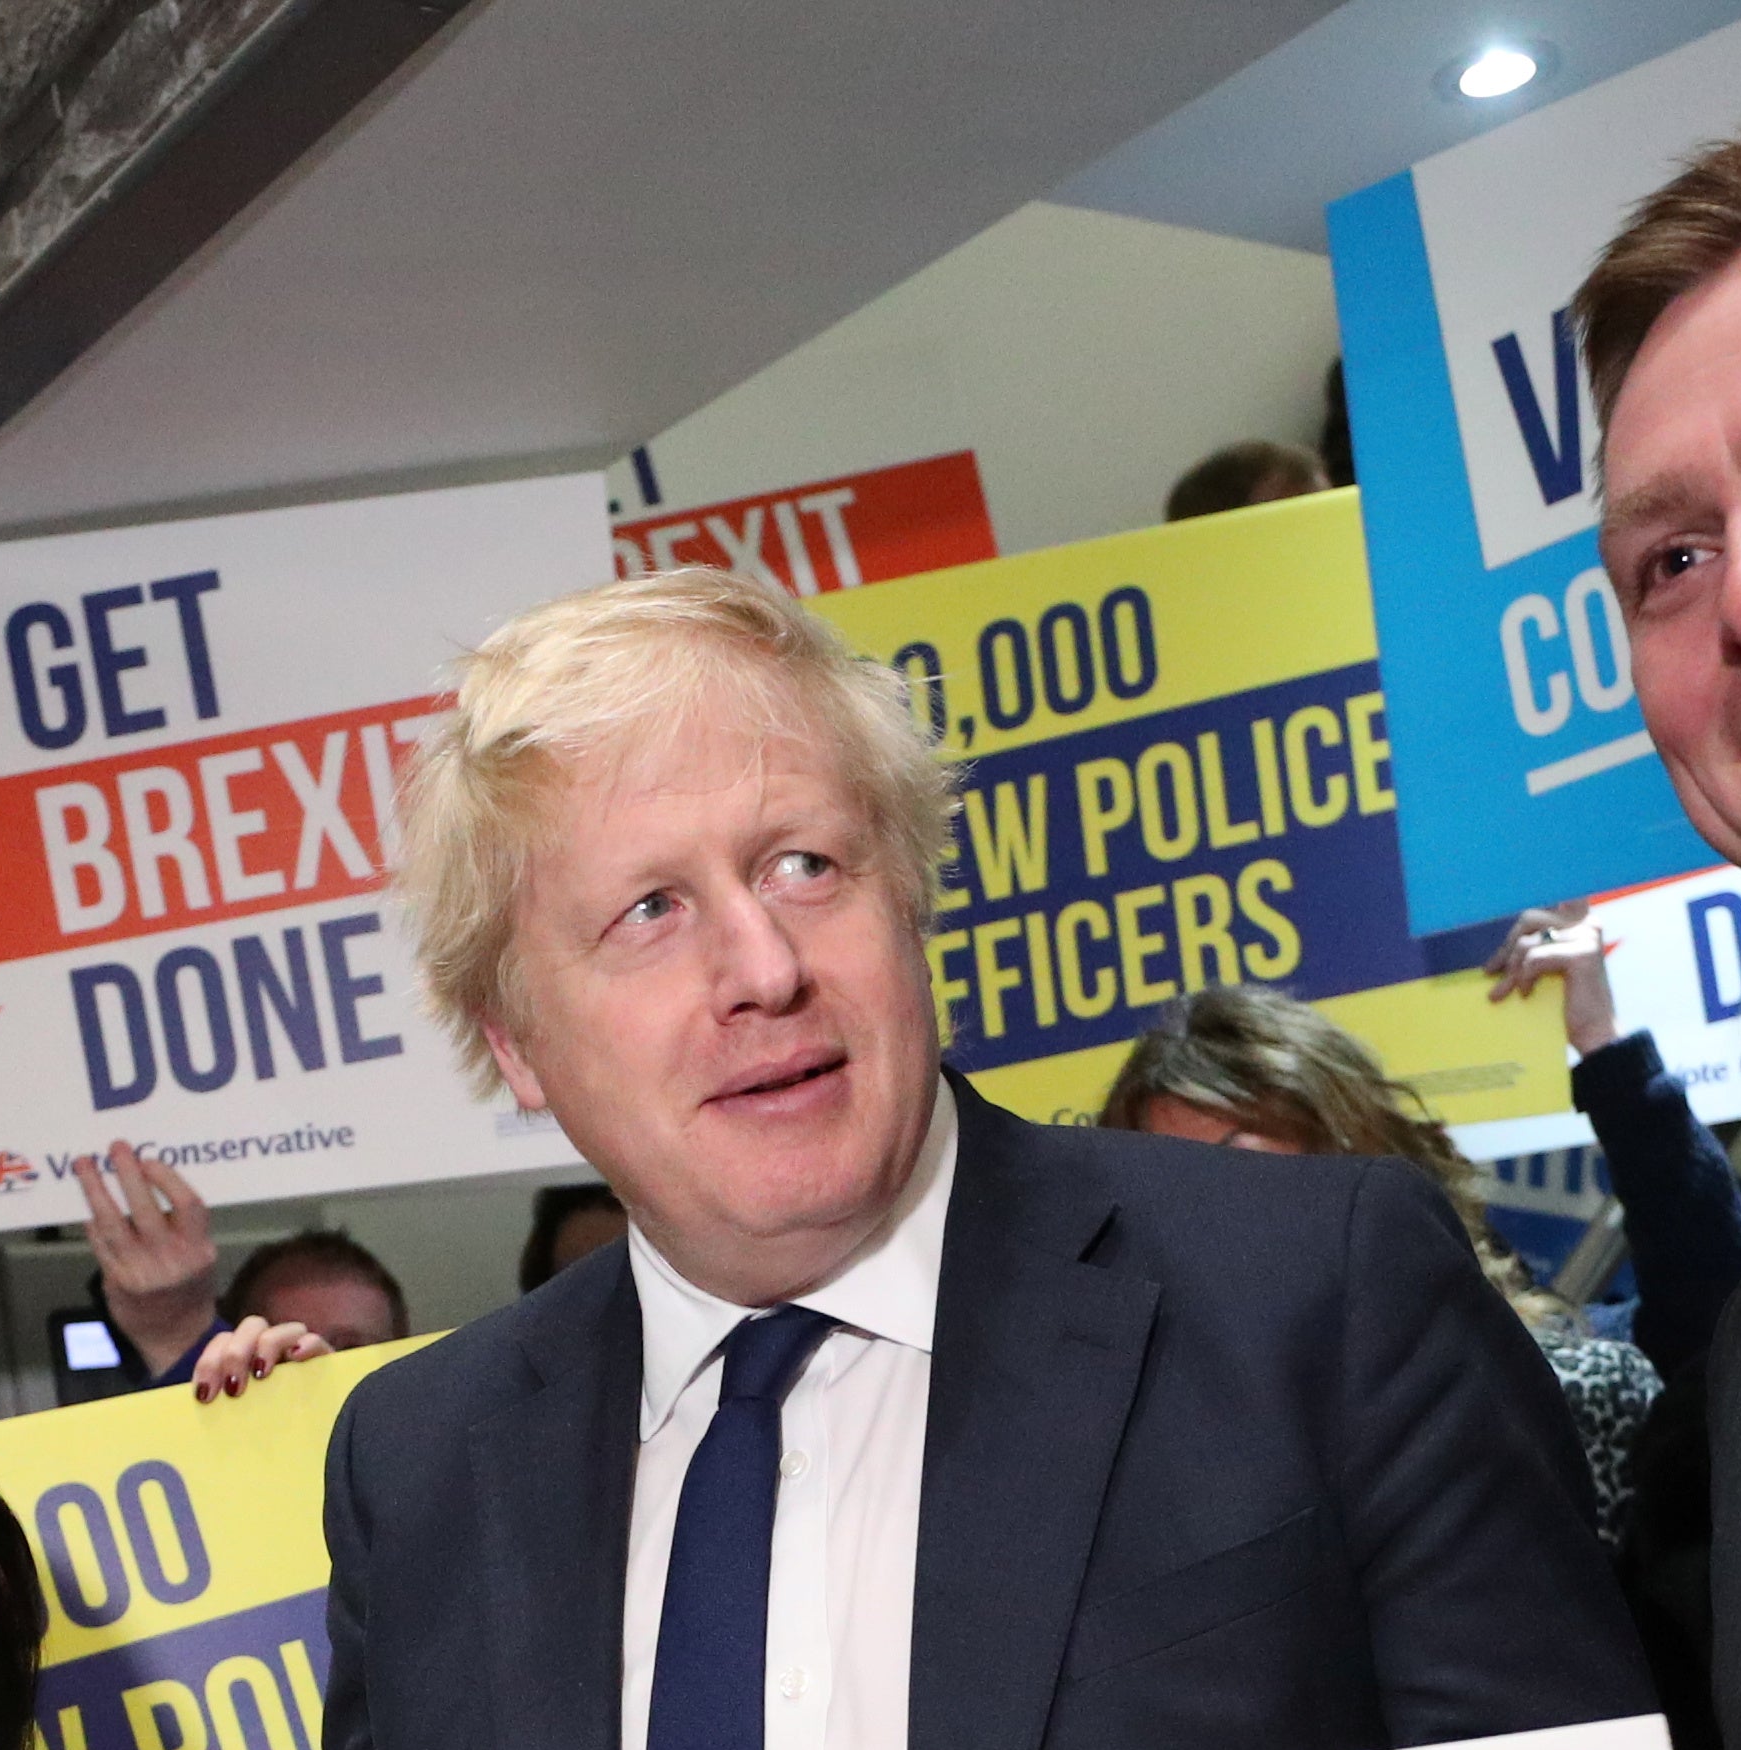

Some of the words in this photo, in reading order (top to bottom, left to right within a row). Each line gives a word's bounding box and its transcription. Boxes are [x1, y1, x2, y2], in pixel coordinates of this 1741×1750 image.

[3, 568, 221, 752] GET
[888, 584, 1157, 748] 0,000
[1075, 691, 1396, 877] POLICE
[70, 912, 403, 1112] DONE
[924, 858, 1300, 1047] FFICERS
[133, 1121, 356, 1170] Conservative
